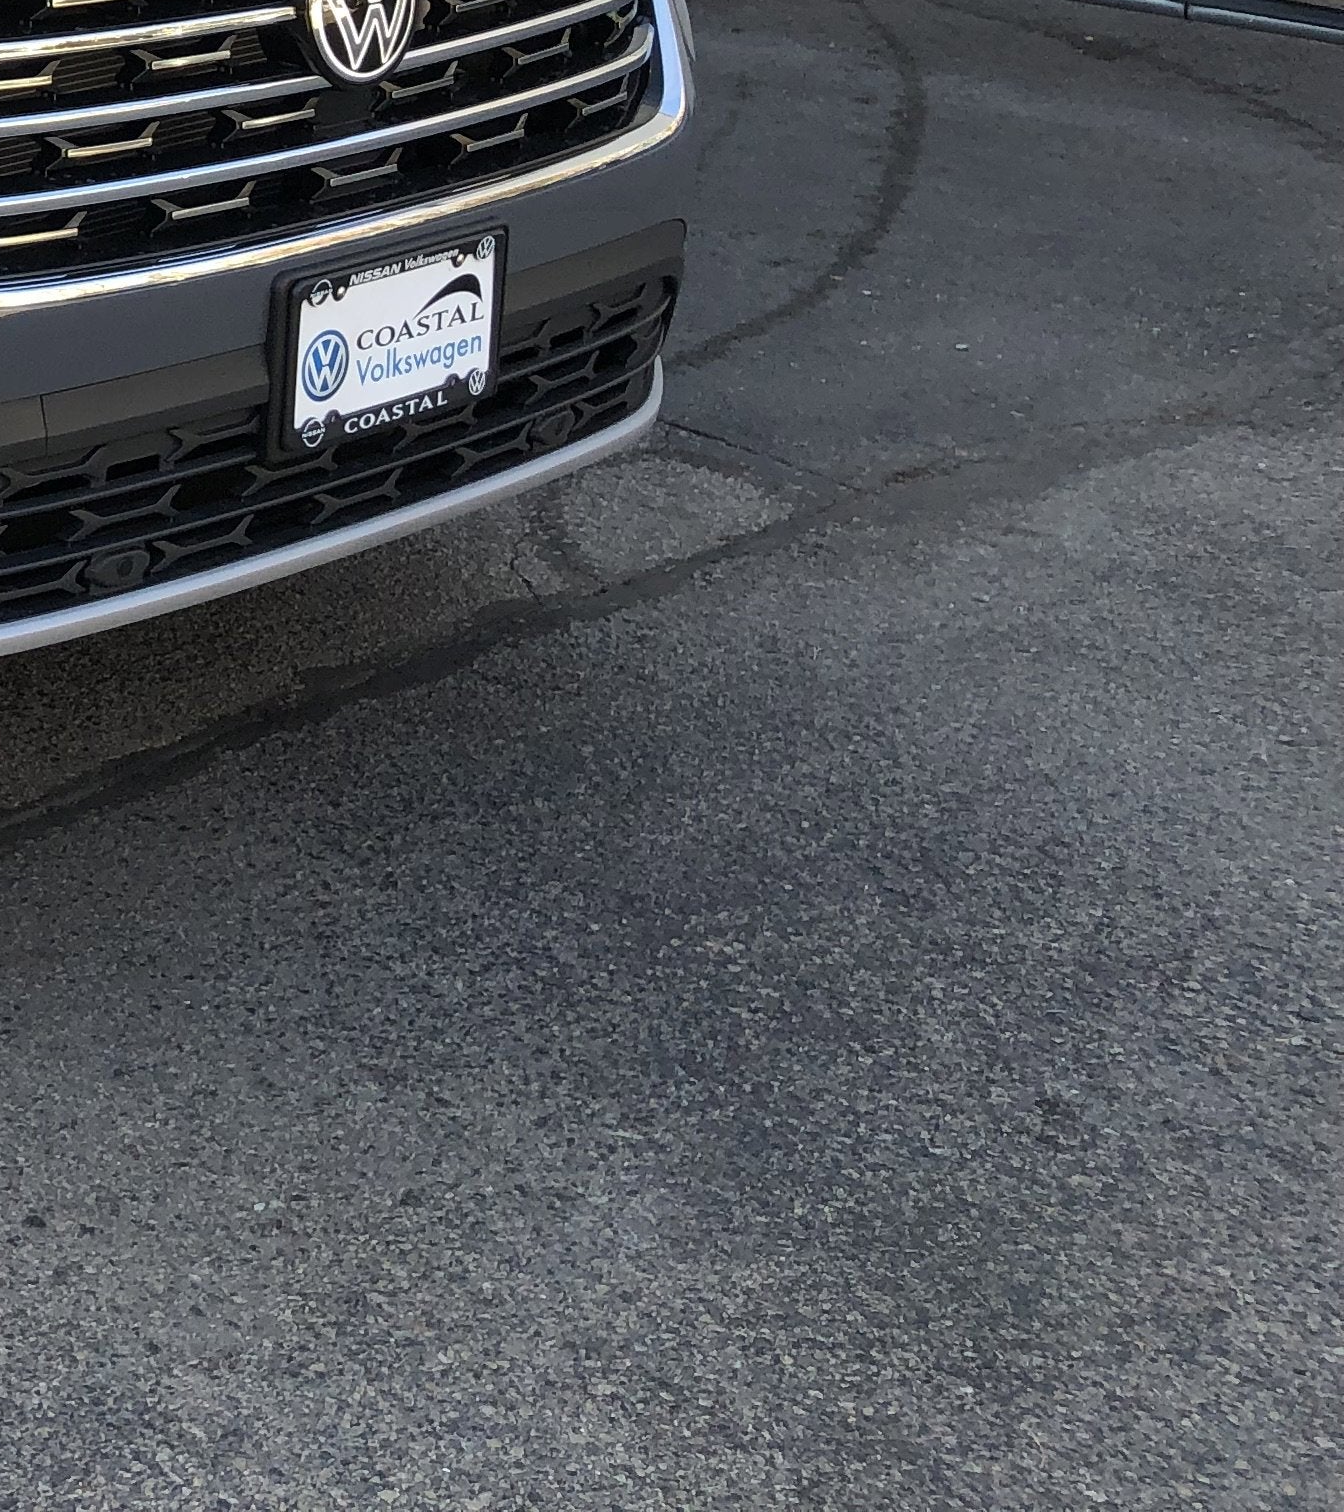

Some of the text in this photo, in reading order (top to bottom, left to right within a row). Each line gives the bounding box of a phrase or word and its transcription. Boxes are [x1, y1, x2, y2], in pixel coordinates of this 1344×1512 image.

[349, 248, 459, 286] NISSAN Volkswagen
[356, 301, 485, 351] COASTAL
[356, 335, 482, 386] Volkswagen
[301, 428, 326, 439] NISSAN
[344, 391, 448, 434] COASTAL
